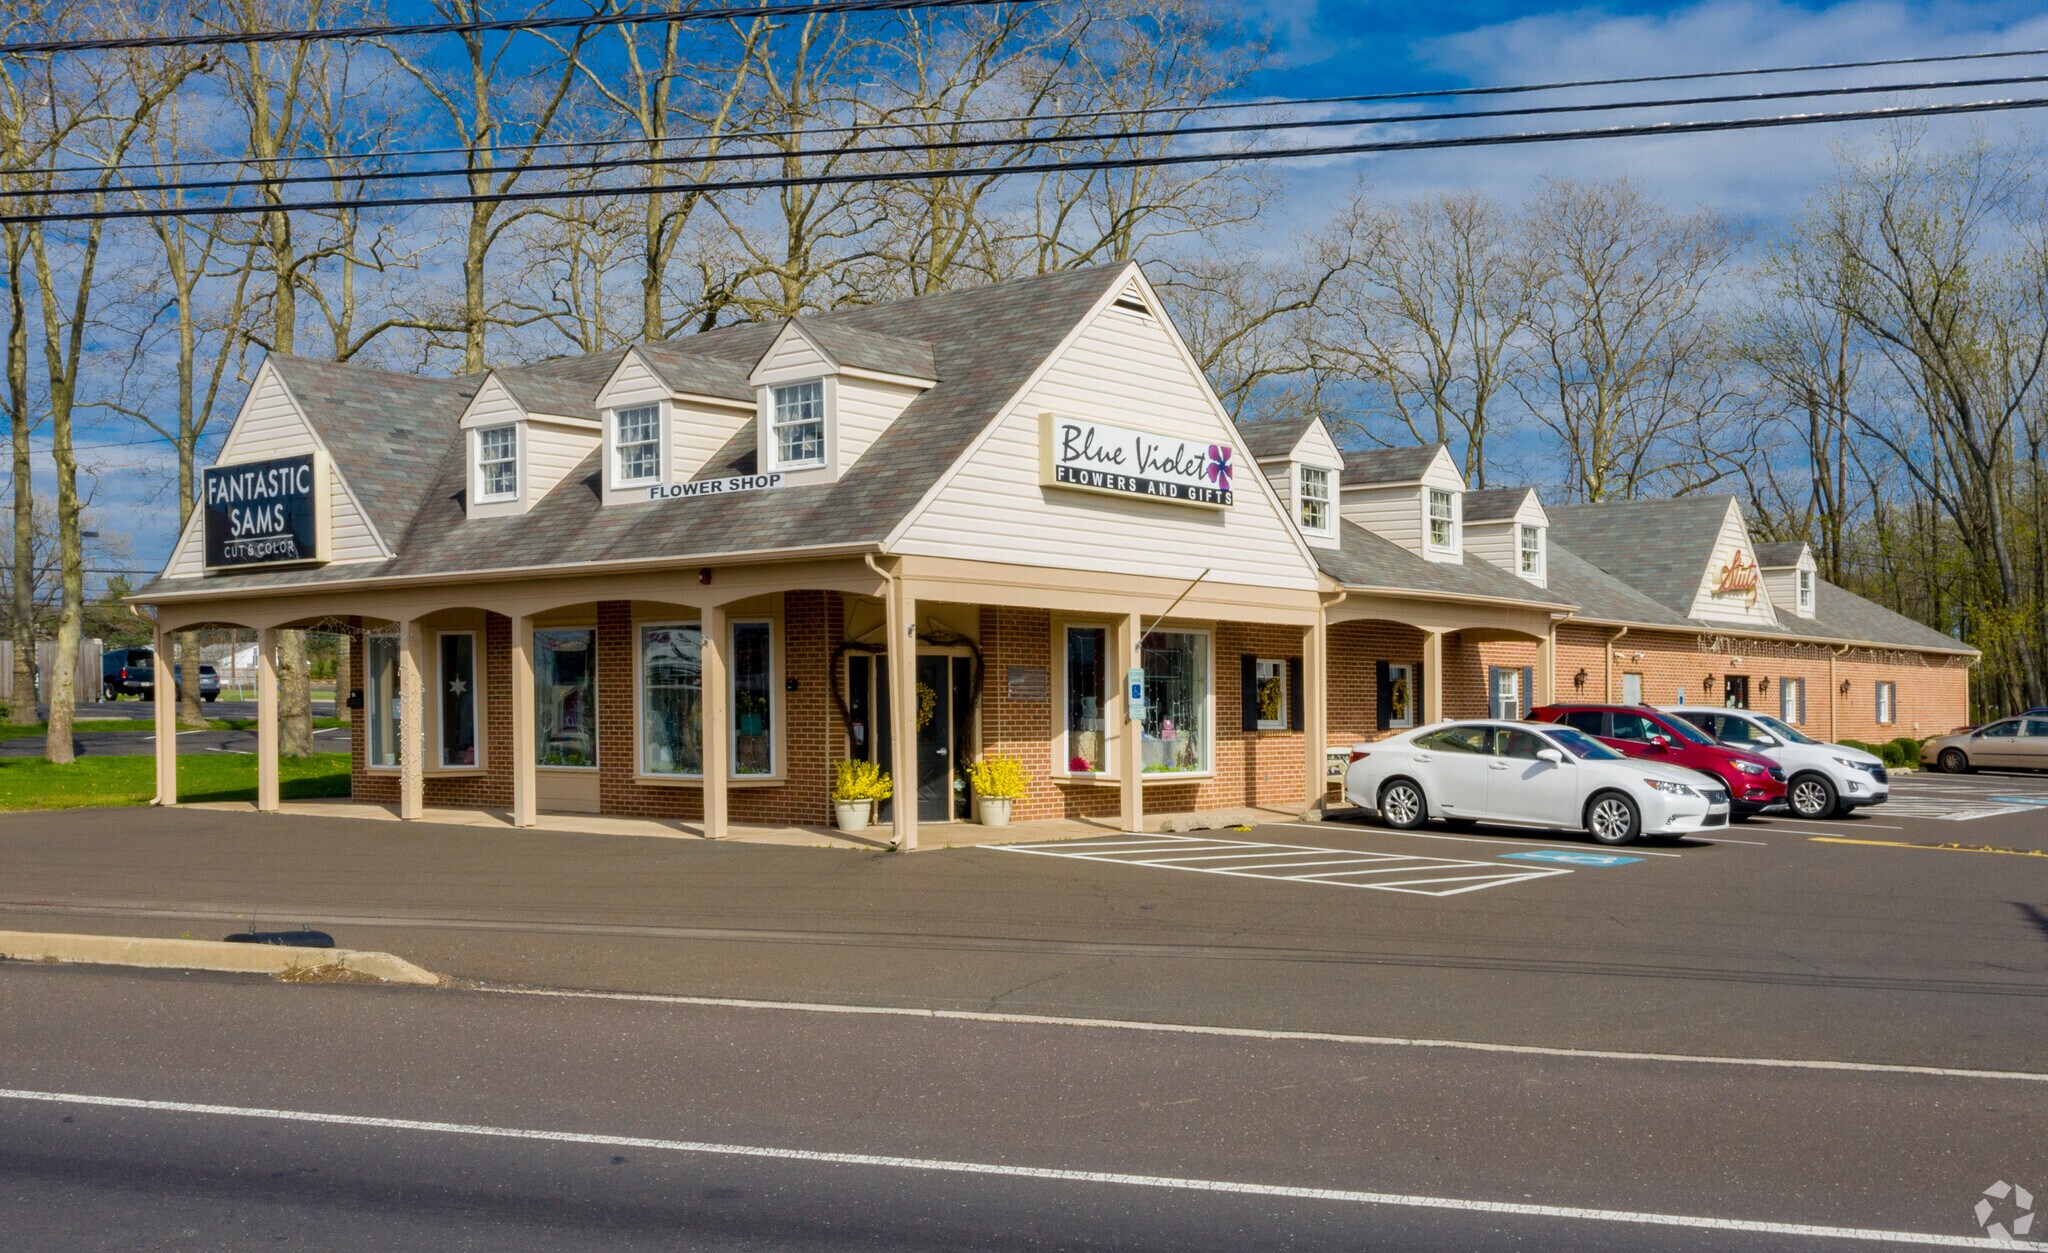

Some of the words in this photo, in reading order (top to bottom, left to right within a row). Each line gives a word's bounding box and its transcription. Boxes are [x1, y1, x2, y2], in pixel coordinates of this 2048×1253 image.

[1061, 424, 1127, 465] Blue
[1136, 436, 1210, 481] Violet
[208, 464, 310, 505] FANTASTIC
[650, 480, 723, 499] FLOWER
[729, 474, 781, 491] SHOP
[1057, 467, 1137, 492] FLOWERS
[1147, 481, 1178, 497] AND
[1188, 487, 1232, 505] GIFTS
[231, 503, 285, 537] SAMS
[224, 545, 245, 559] CUT
[247, 544, 254, 556] &
[257, 540, 295, 555] COLOR
